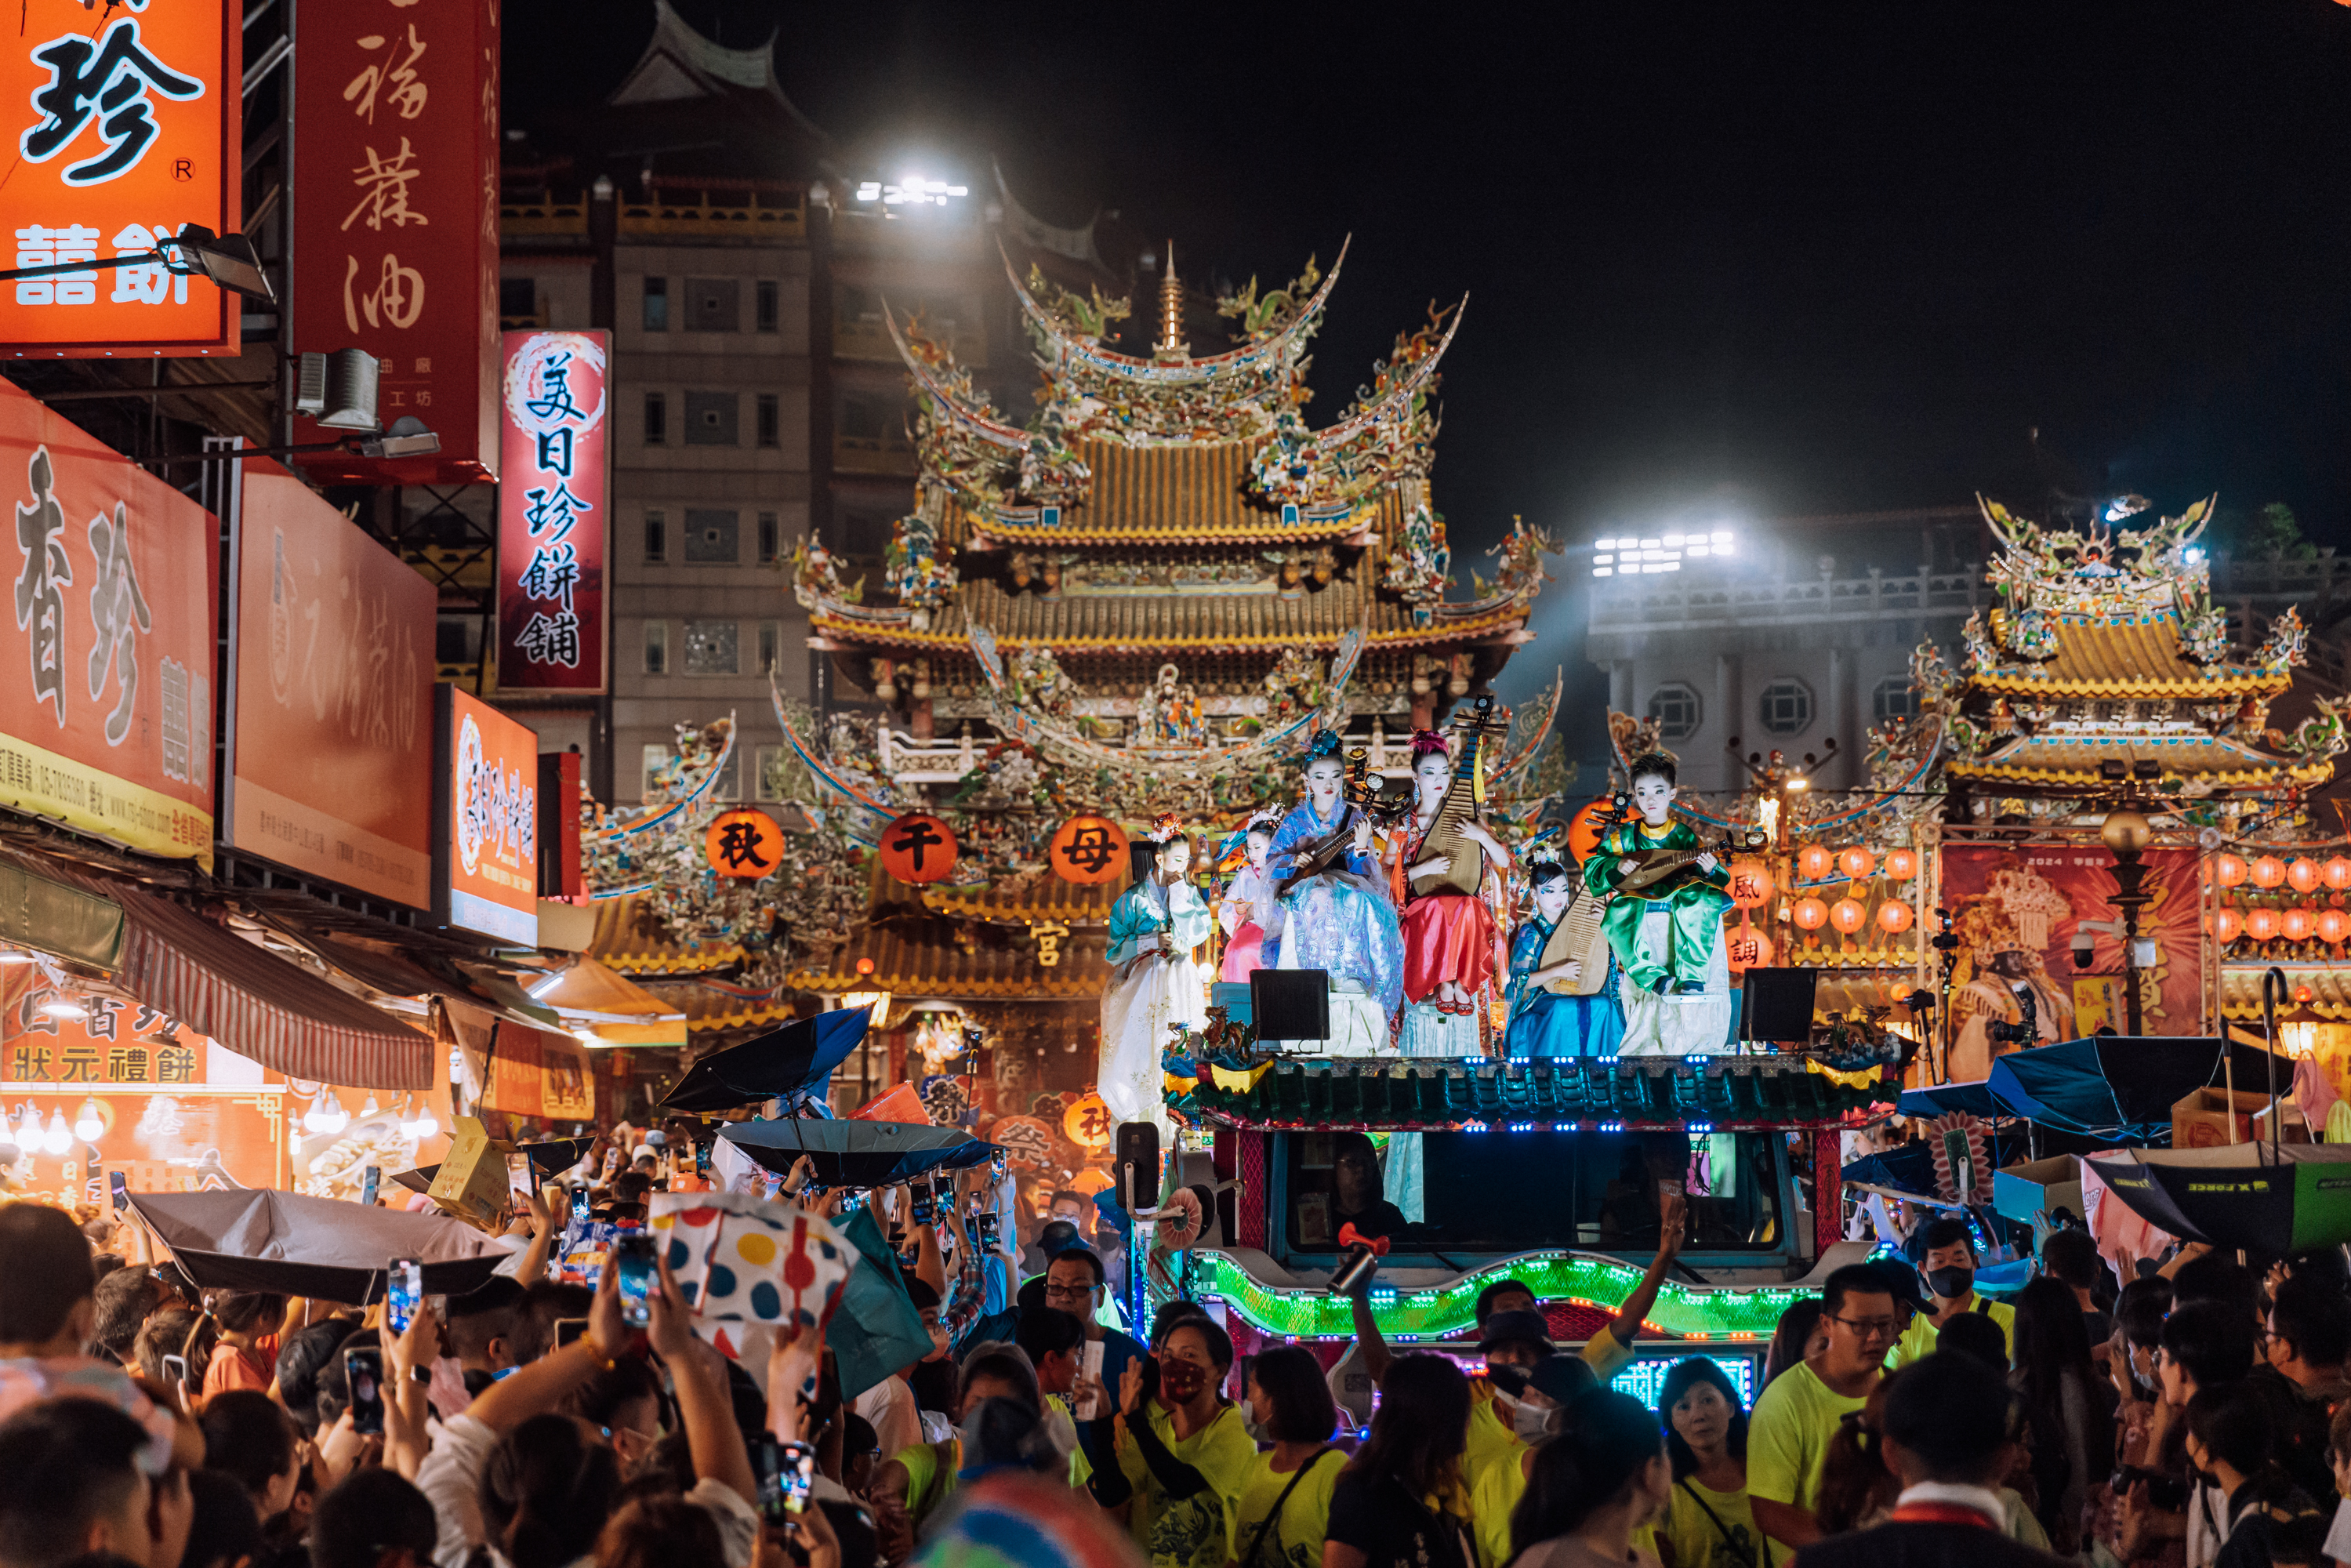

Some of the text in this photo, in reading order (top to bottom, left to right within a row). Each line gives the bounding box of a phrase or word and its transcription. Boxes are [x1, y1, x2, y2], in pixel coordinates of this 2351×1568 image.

[20, 0, 205, 187] 珍
[342, 0, 429, 335] 福蔴油
[719, 822, 770, 869] 秋
[892, 822, 942, 872] 千
[1061, 827, 1119, 873] 母
[2027, 857, 2063, 866] 2024
[1734, 873, 1760, 899] 風
[1029, 920, 1070, 967] 宮
[1730, 938, 1758, 965] 調
[13, 1047, 197, 1083] 狀元禮餅
[2188, 1182, 2235, 1192] FORCE
